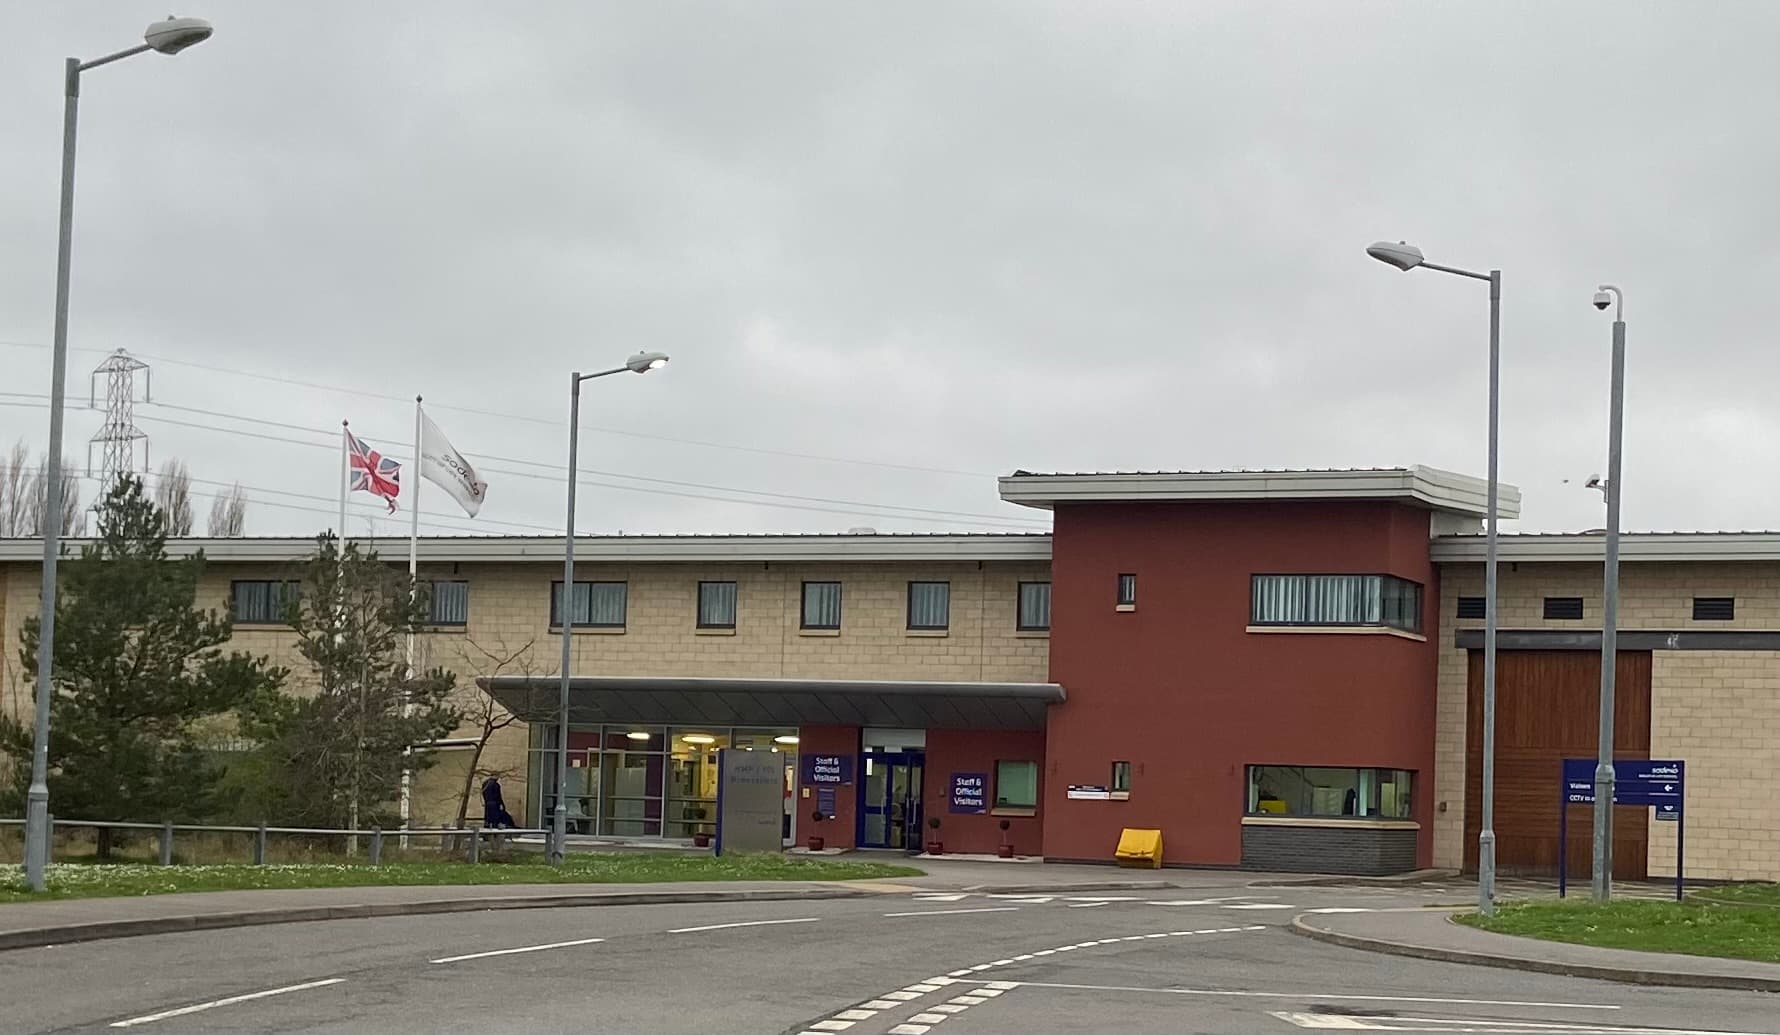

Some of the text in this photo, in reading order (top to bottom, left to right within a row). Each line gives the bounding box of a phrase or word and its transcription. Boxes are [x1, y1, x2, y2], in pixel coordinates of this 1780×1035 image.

[816, 757, 832, 765] Staff
[815, 766, 840, 774] Official
[813, 774, 841, 782] Visitors
[956, 777, 975, 786] Staff
[955, 787, 982, 796] Official
[954, 797, 983, 806] Visitors
